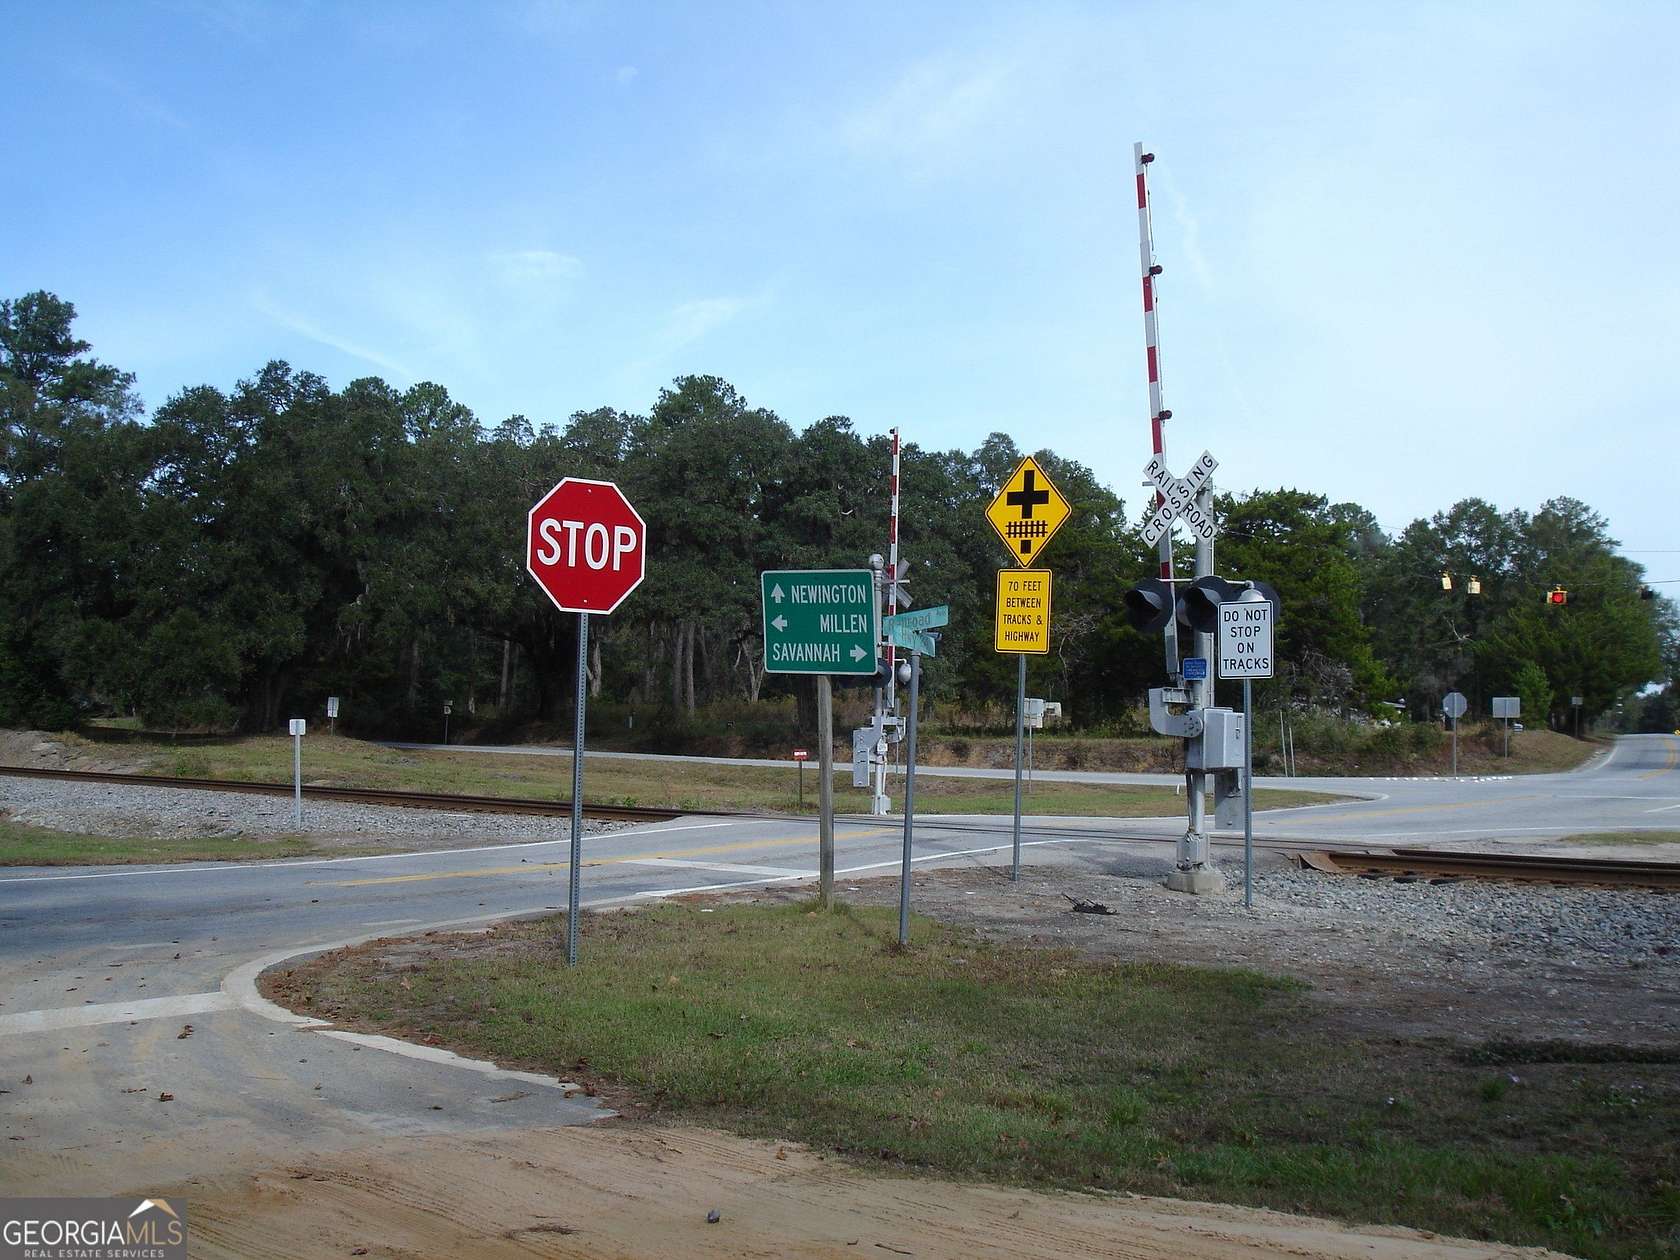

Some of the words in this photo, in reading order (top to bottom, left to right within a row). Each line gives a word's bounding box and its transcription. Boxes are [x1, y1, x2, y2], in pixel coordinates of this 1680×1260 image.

[1145, 455, 1214, 542] CROSSING
[1147, 460, 1177, 497] RAIL
[1183, 503, 1213, 540] ROAD
[537, 517, 637, 571] STOP
[1008, 581, 1019, 592] 70
[1022, 581, 1041, 592] FEET
[791, 585, 866, 604] NEWINGTON
[1006, 597, 1041, 608] BETWEEN
[1003, 614, 1031, 625] TRACKS
[1036, 615, 1043, 625] &
[1223, 610, 1239, 622] DO
[1245, 609, 1268, 621] NOT
[820, 614, 868, 633] MILLEN
[1004, 631, 1040, 643] HIGHWAY
[1230, 626, 1261, 638] STOP
[772, 643, 840, 663] SAVANNAH
[1237, 642, 1254, 654] ON
[1223, 658, 1269, 671] TRACKS
